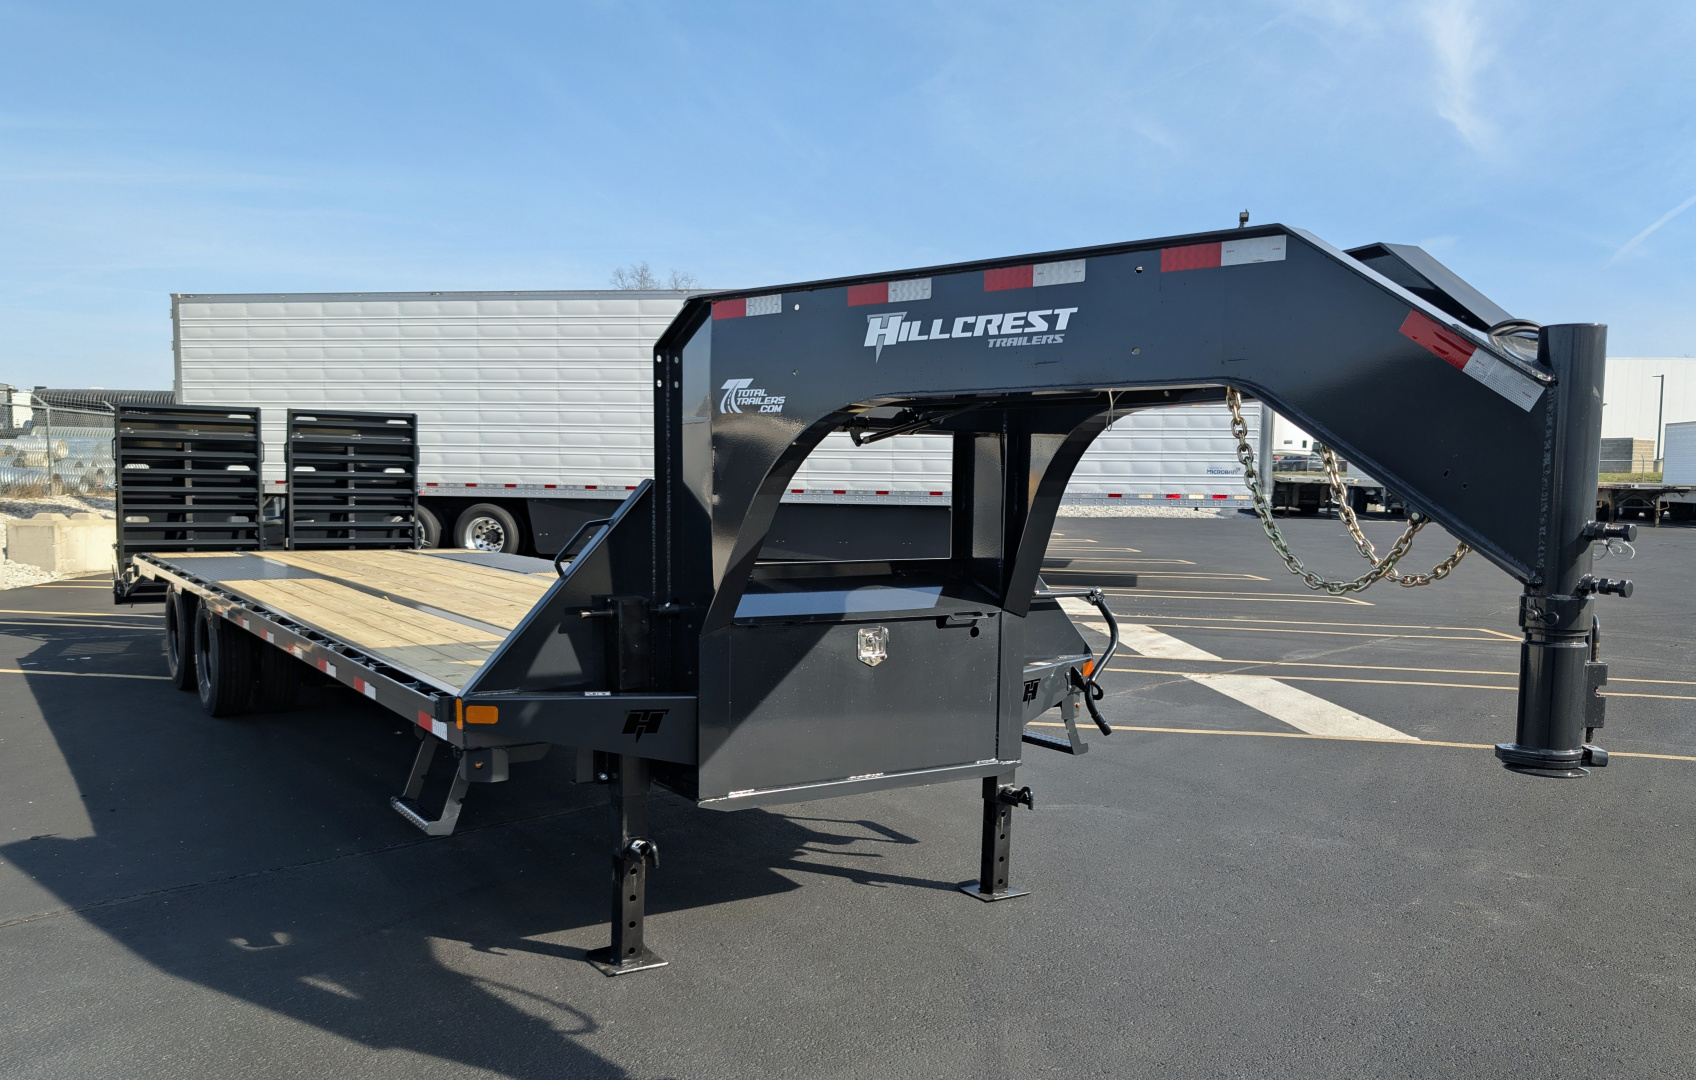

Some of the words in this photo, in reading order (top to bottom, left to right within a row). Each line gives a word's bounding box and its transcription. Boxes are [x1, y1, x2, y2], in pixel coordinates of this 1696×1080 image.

[864, 307, 1079, 356] HILLCREST
[987, 333, 1065, 348] TRAILERS
[737, 388, 767, 398] TOTAL
[736, 396, 786, 406] TRAILERS
[757, 404, 783, 413] .COM
